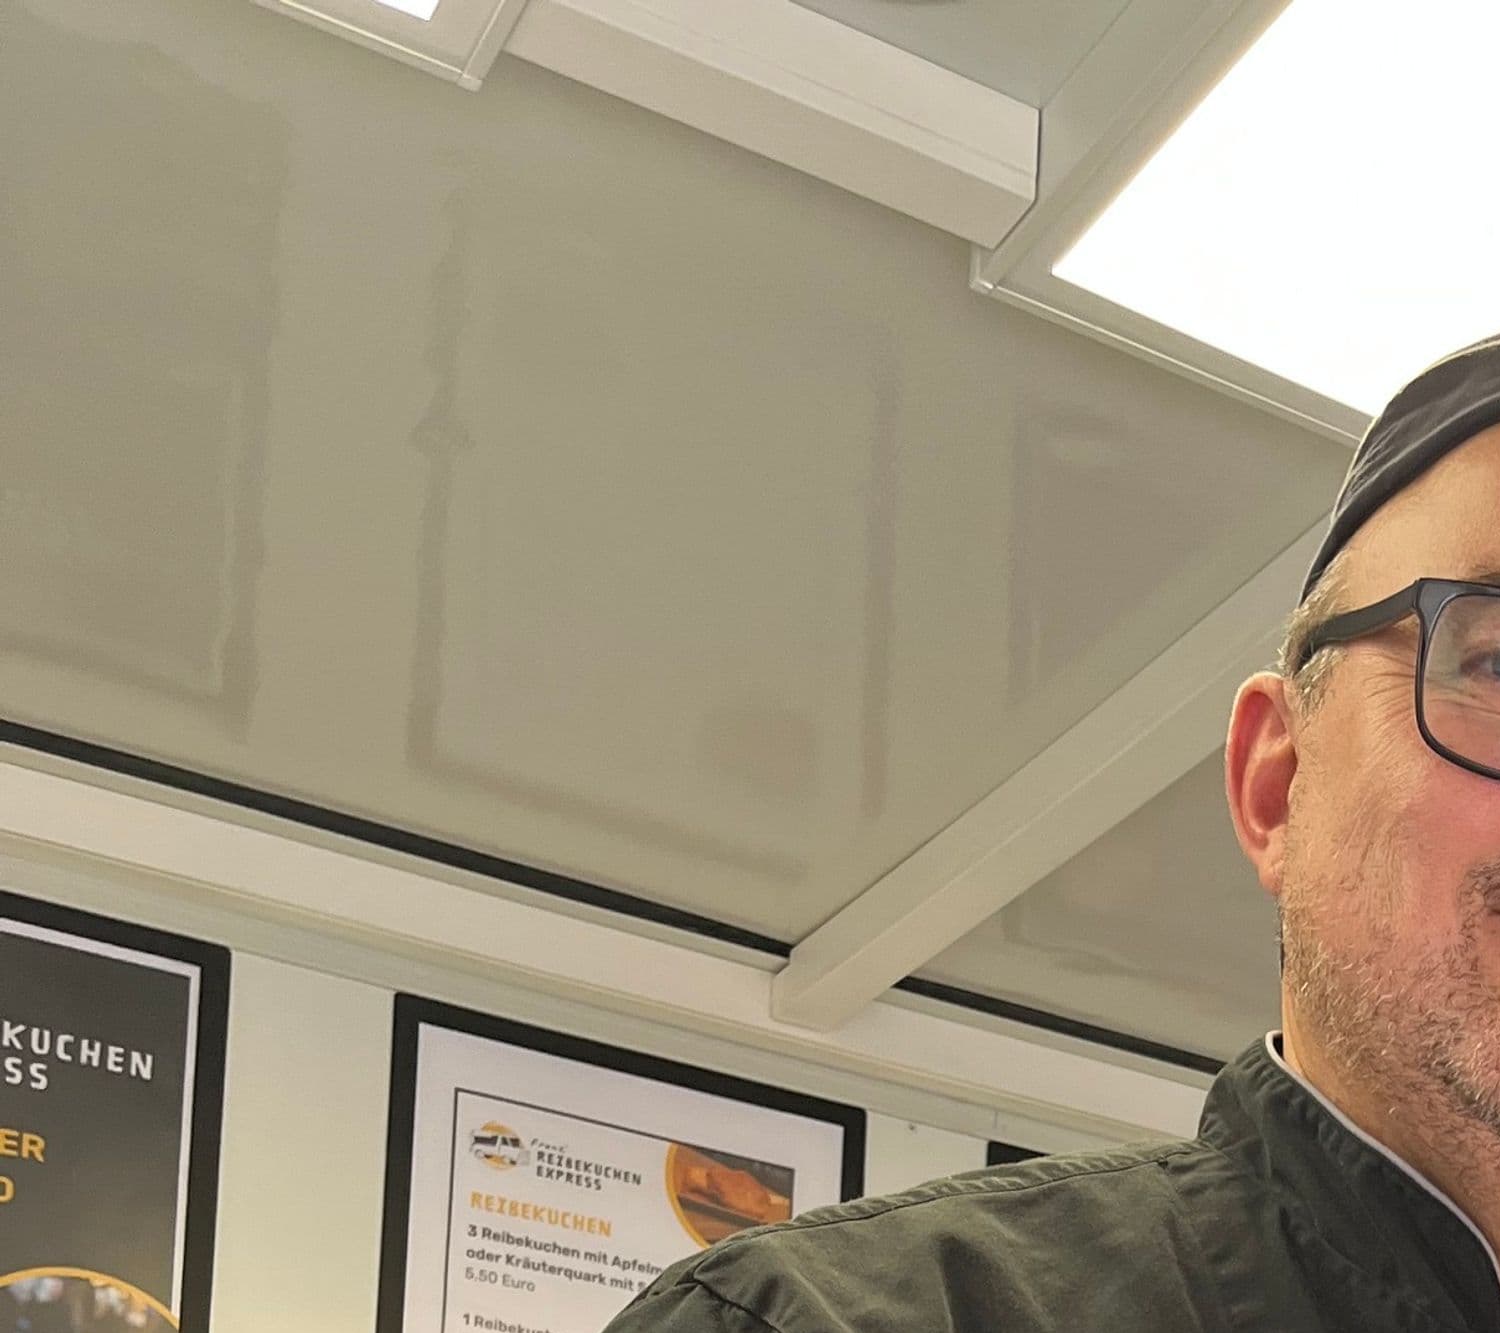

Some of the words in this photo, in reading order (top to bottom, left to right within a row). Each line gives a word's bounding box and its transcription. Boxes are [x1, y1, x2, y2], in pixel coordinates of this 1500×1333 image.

[2, 1020, 153, 1080] KUCHEN
[536, 1150, 642, 1186] REIBEKUCHEN
[536, 1165, 602, 1192] EXPRESS
[470, 1191, 612, 1238] REIBEKUCHEN
[467, 1224, 478, 1238] 3
[481, 1227, 580, 1259] Reibekuchen
[584, 1251, 608, 1266] mit
[466, 1249, 502, 1264] oder
[505, 1253, 607, 1286] Kräuterquark
[610, 1277, 634, 1291] mit
[502, 1273, 536, 1293] Euro
[463, 1313, 470, 1326] 1
